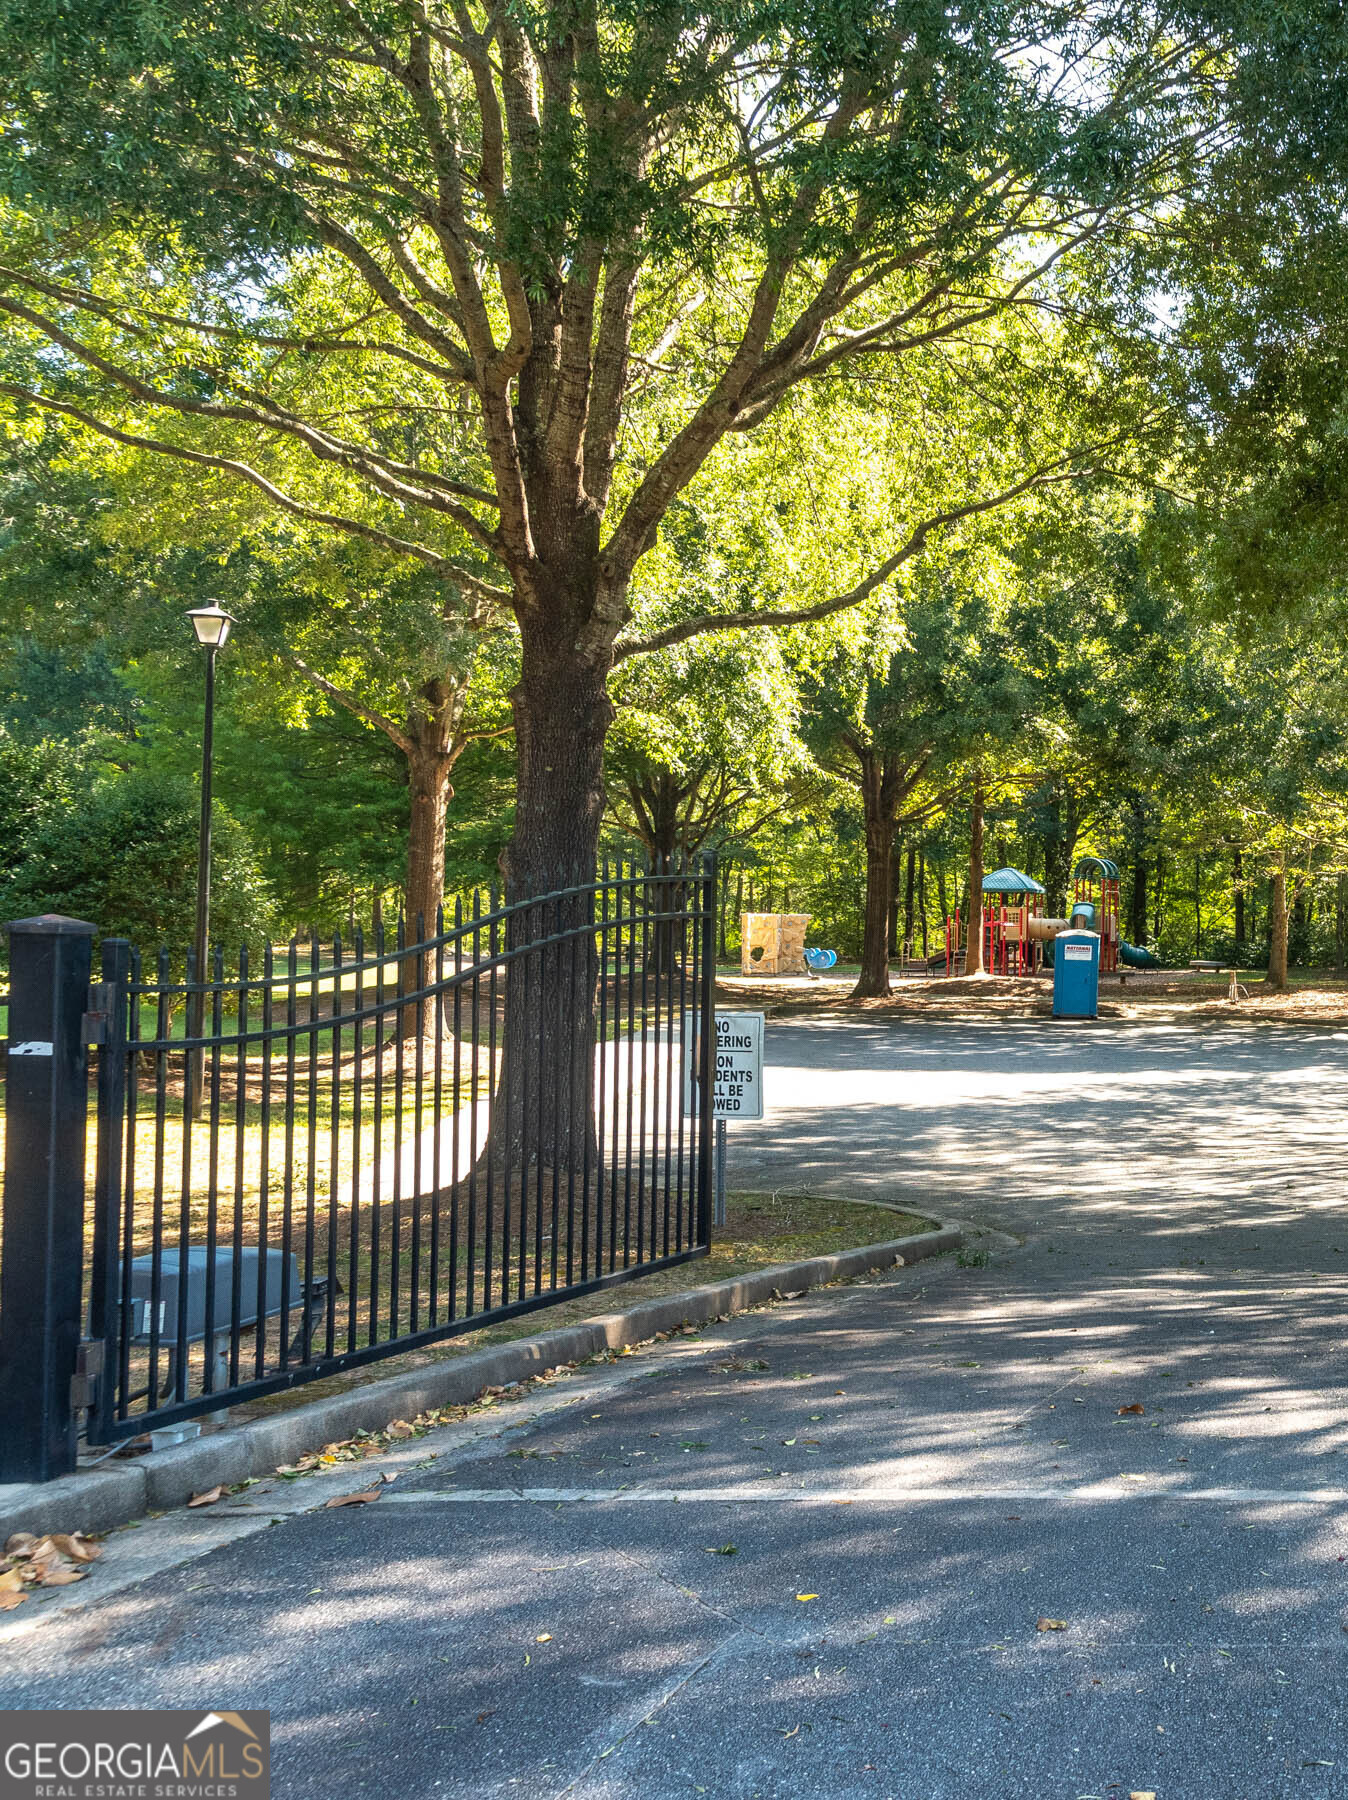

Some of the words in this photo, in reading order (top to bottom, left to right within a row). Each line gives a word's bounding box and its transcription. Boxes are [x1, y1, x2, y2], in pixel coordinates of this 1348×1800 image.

[715, 1021, 730, 1033] NO
[717, 1035, 752, 1048] ERING
[717, 1055, 733, 1068] ON
[715, 1070, 753, 1083] DENTS
[729, 1084, 744, 1097] BE
[714, 1098, 741, 1111] WED
